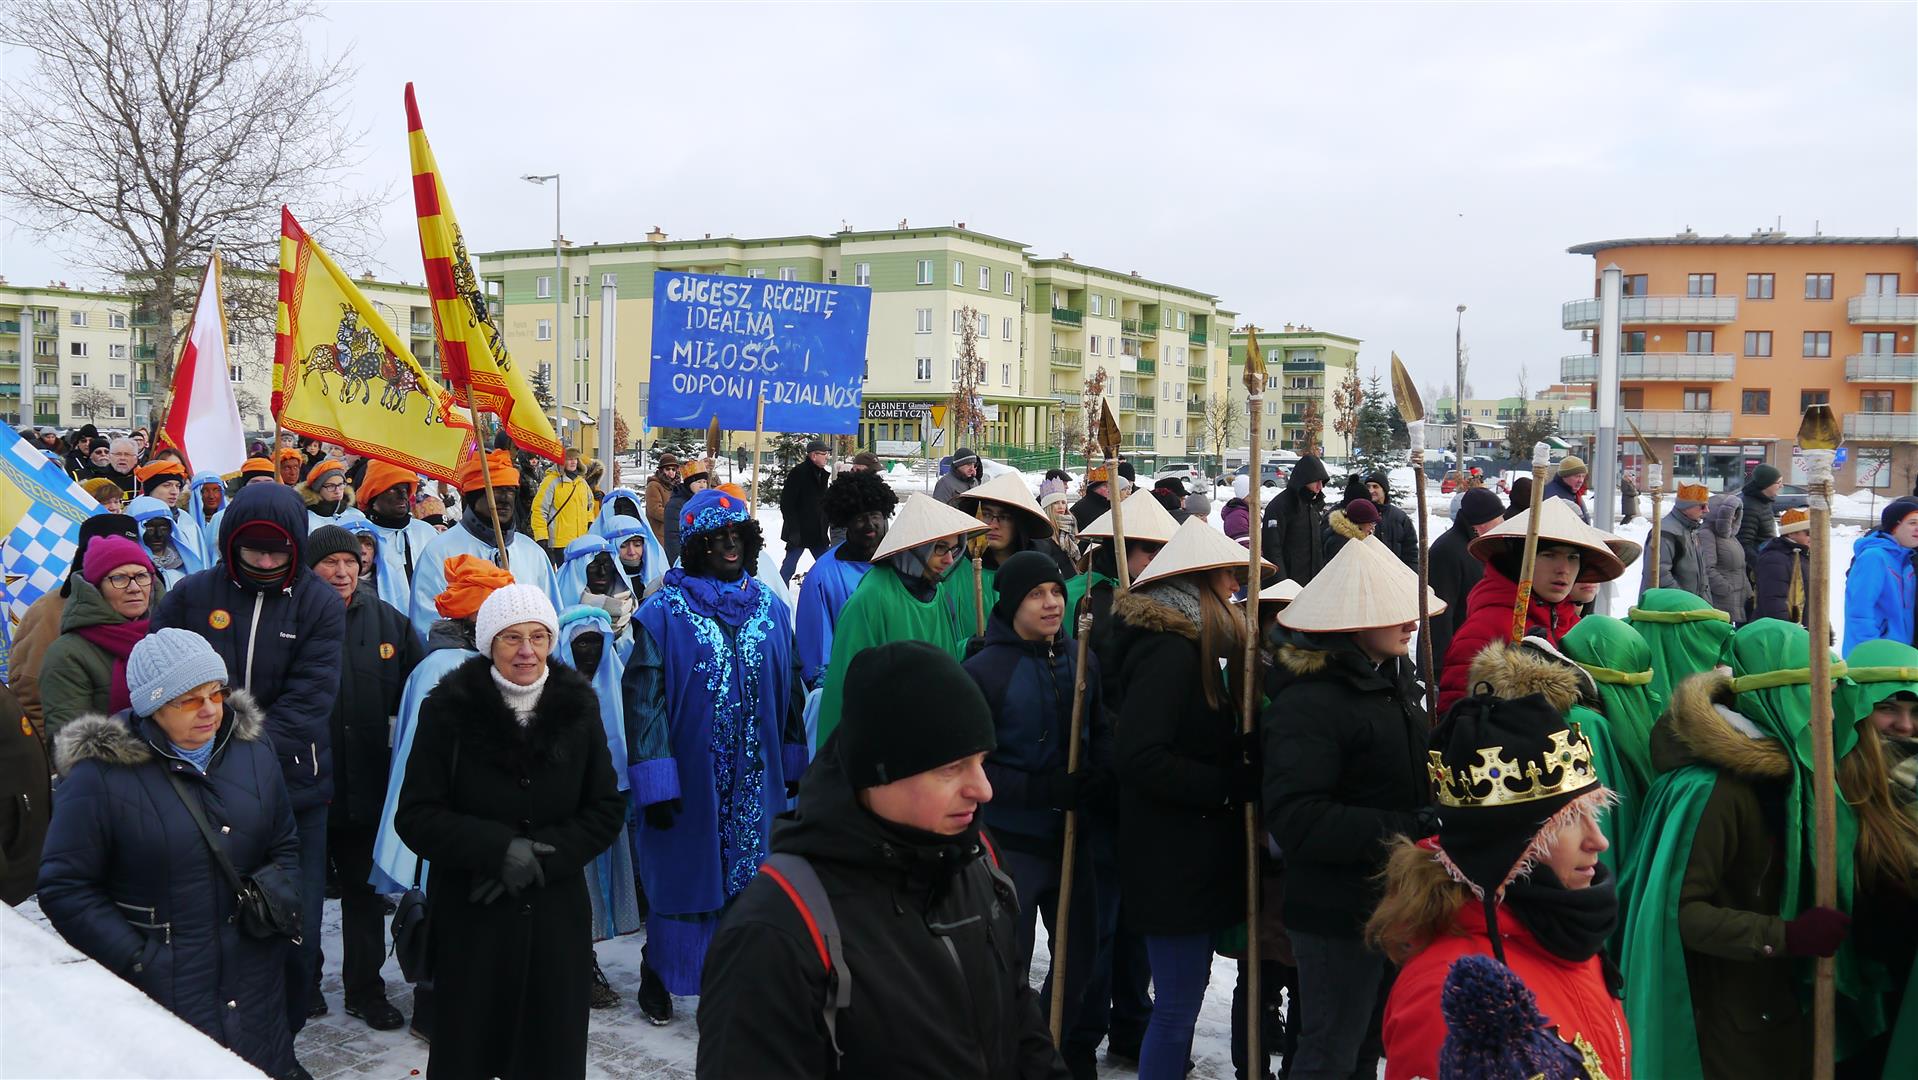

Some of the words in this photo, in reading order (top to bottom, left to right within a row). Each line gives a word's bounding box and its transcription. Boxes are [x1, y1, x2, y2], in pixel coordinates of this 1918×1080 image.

[667, 276, 752, 309] CHCESZ
[763, 283, 839, 319] RECEPTĘ
[685, 306, 775, 340] IDEALNĄ
[670, 339, 780, 372] MIŁOŚĆ
[803, 349, 810, 373] I
[868, 402, 907, 410] GABINET
